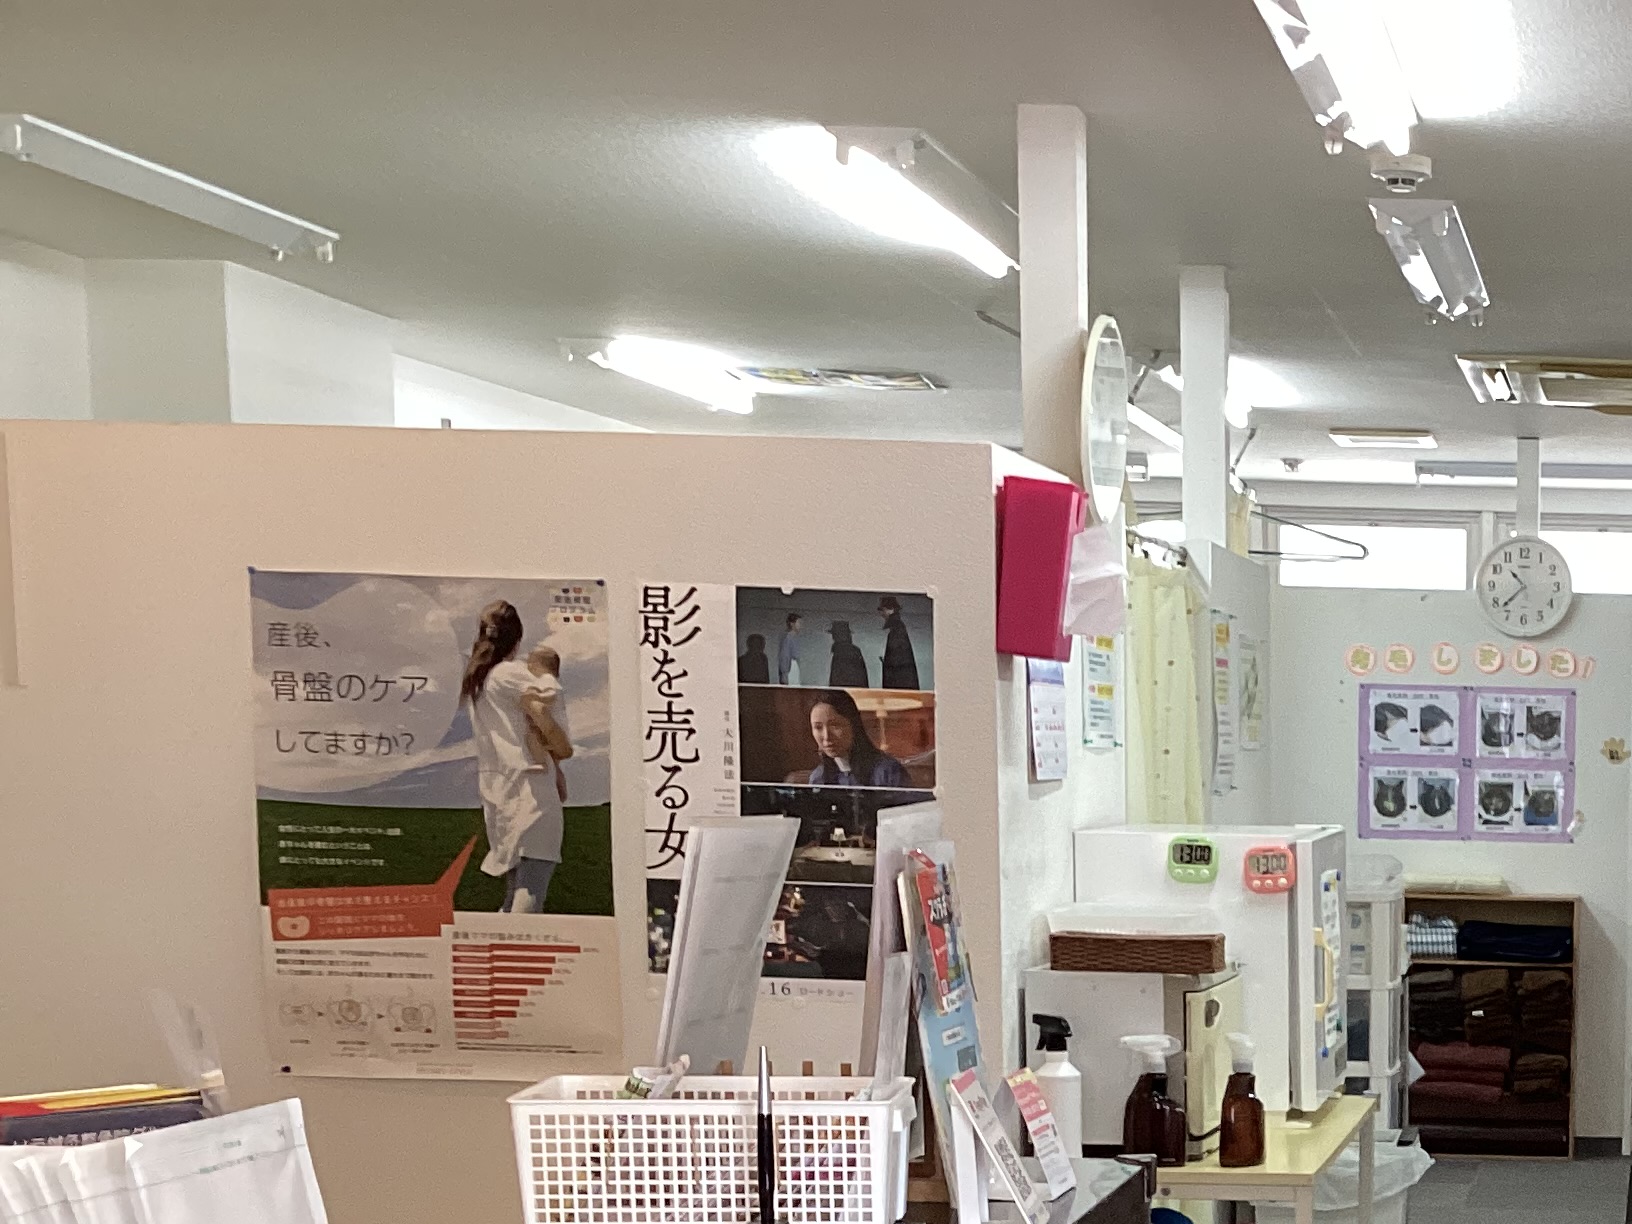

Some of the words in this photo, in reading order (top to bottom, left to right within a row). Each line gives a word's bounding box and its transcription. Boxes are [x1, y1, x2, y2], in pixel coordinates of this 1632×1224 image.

[1519, 547, 1531, 560] 12
[270, 670, 429, 704] 骨盤のケア
[639, 584, 702, 871] 影を売る女
